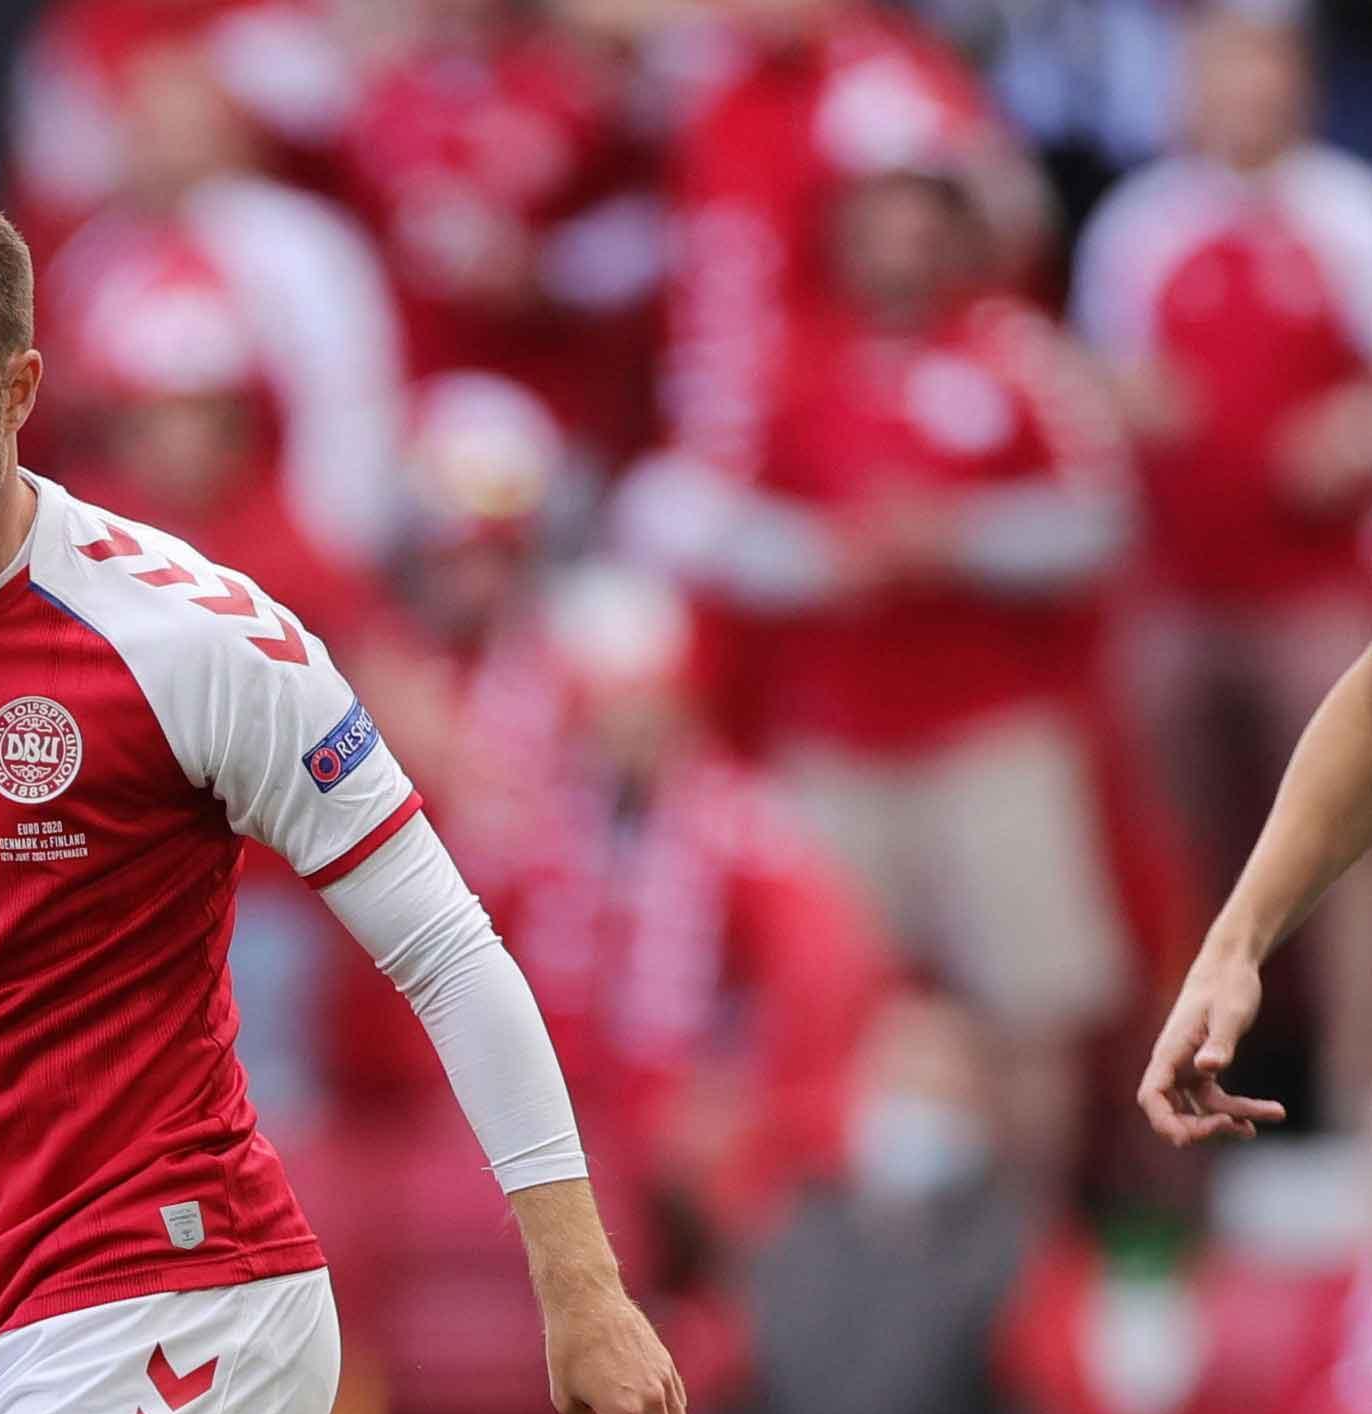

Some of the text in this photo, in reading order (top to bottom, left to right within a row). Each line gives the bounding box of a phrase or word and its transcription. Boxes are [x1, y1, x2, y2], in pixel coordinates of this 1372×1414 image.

[4, 732, 61, 764] DBU
[53, 733, 78, 787] UNION
[10, 783, 49, 798] 1889
[17, 820, 63, 835] EURO 2020
[49, 833, 86, 848] FINLAND
